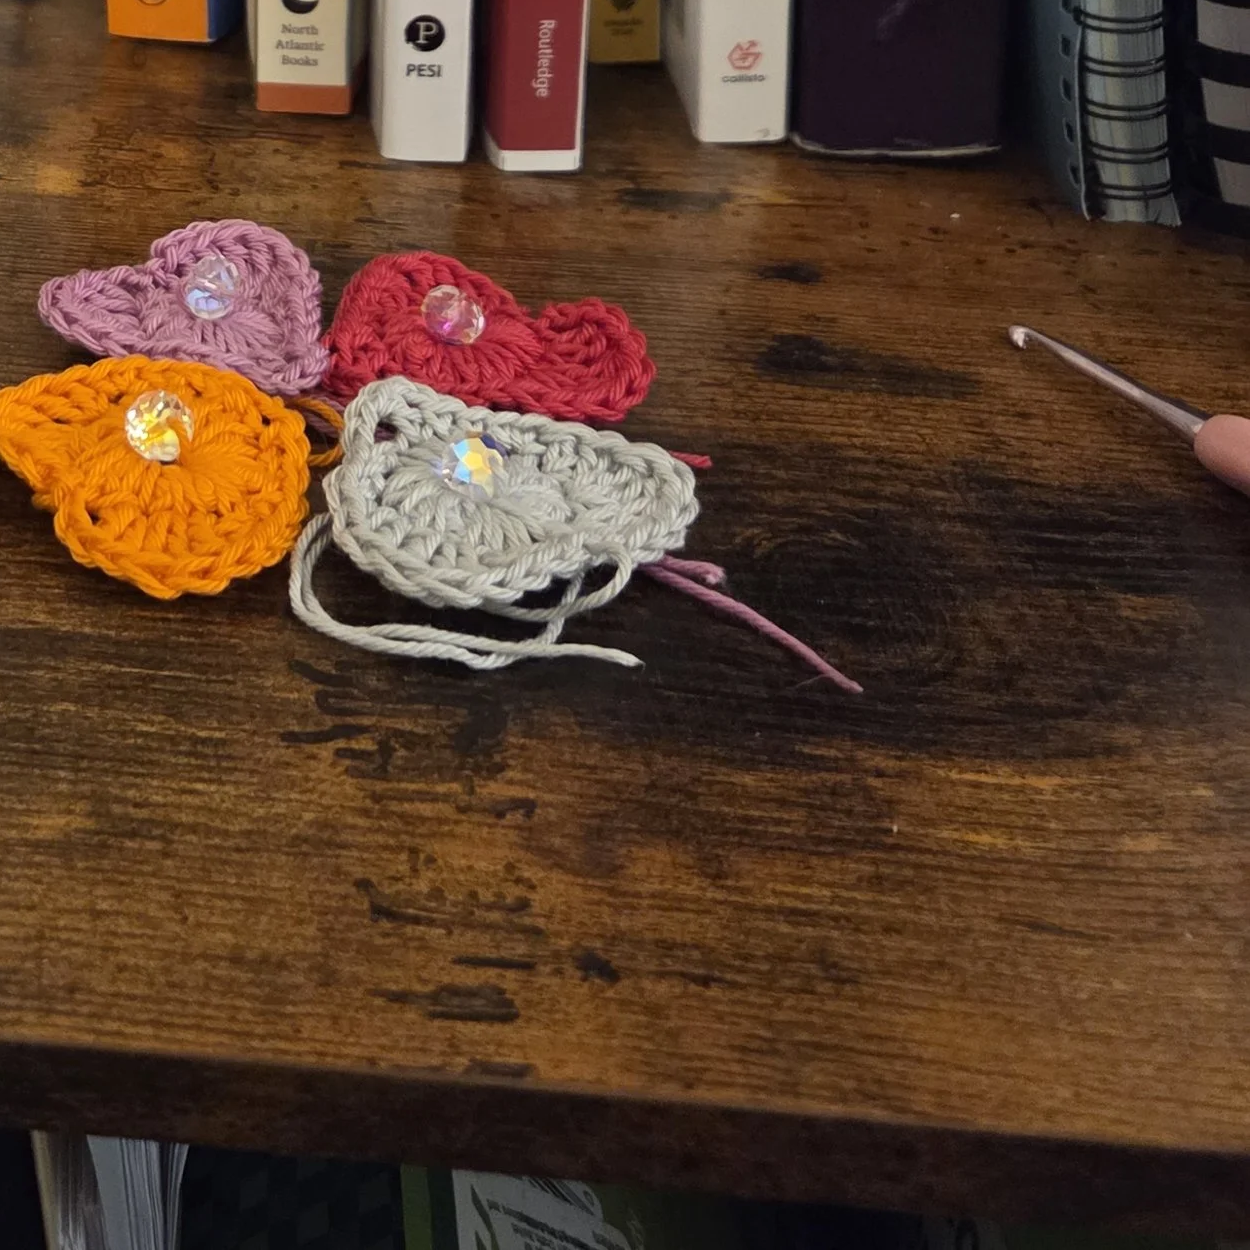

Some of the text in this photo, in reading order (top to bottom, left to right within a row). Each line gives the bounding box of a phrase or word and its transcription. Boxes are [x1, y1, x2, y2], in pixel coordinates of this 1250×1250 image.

[280, 22, 319, 36] North
[274, 37, 325, 52] Atlantic
[280, 53, 319, 68] Books
[405, 62, 443, 79] PESI
